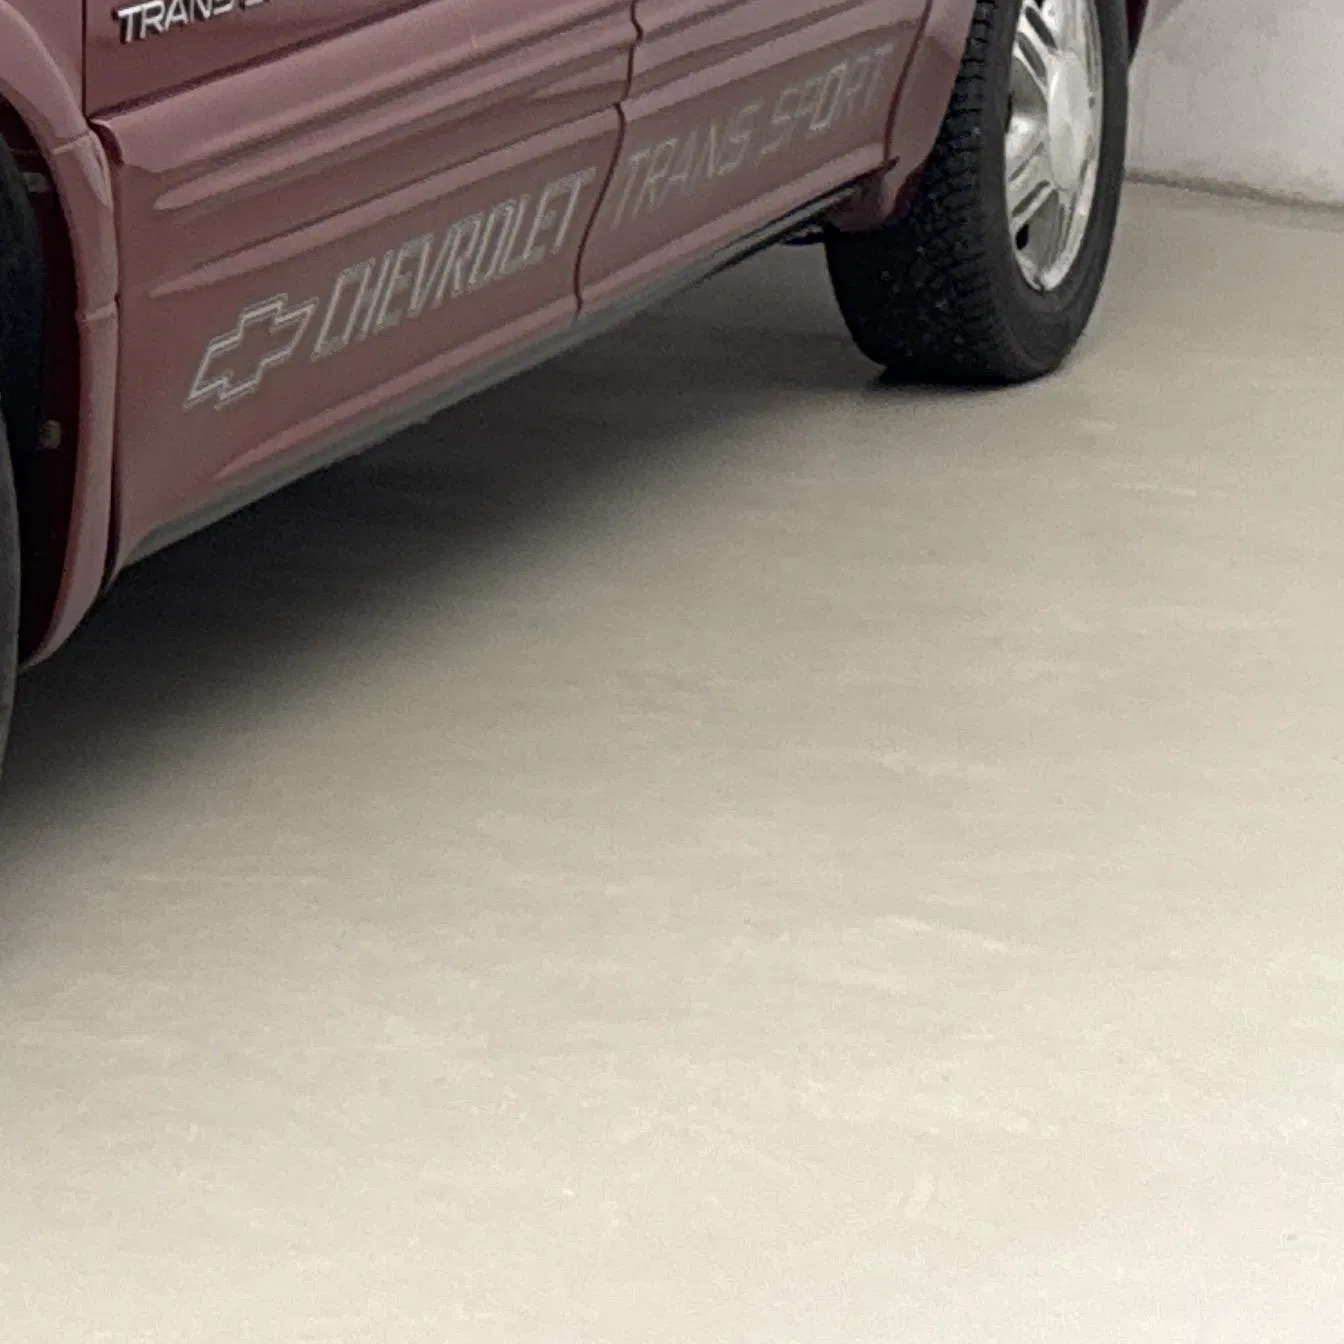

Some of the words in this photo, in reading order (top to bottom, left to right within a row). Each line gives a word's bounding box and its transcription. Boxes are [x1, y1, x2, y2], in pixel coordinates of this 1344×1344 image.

[312, 167, 596, 362] CHEVROLET
[611, 97, 764, 232] TRANS
[758, 44, 893, 163] SPORT
